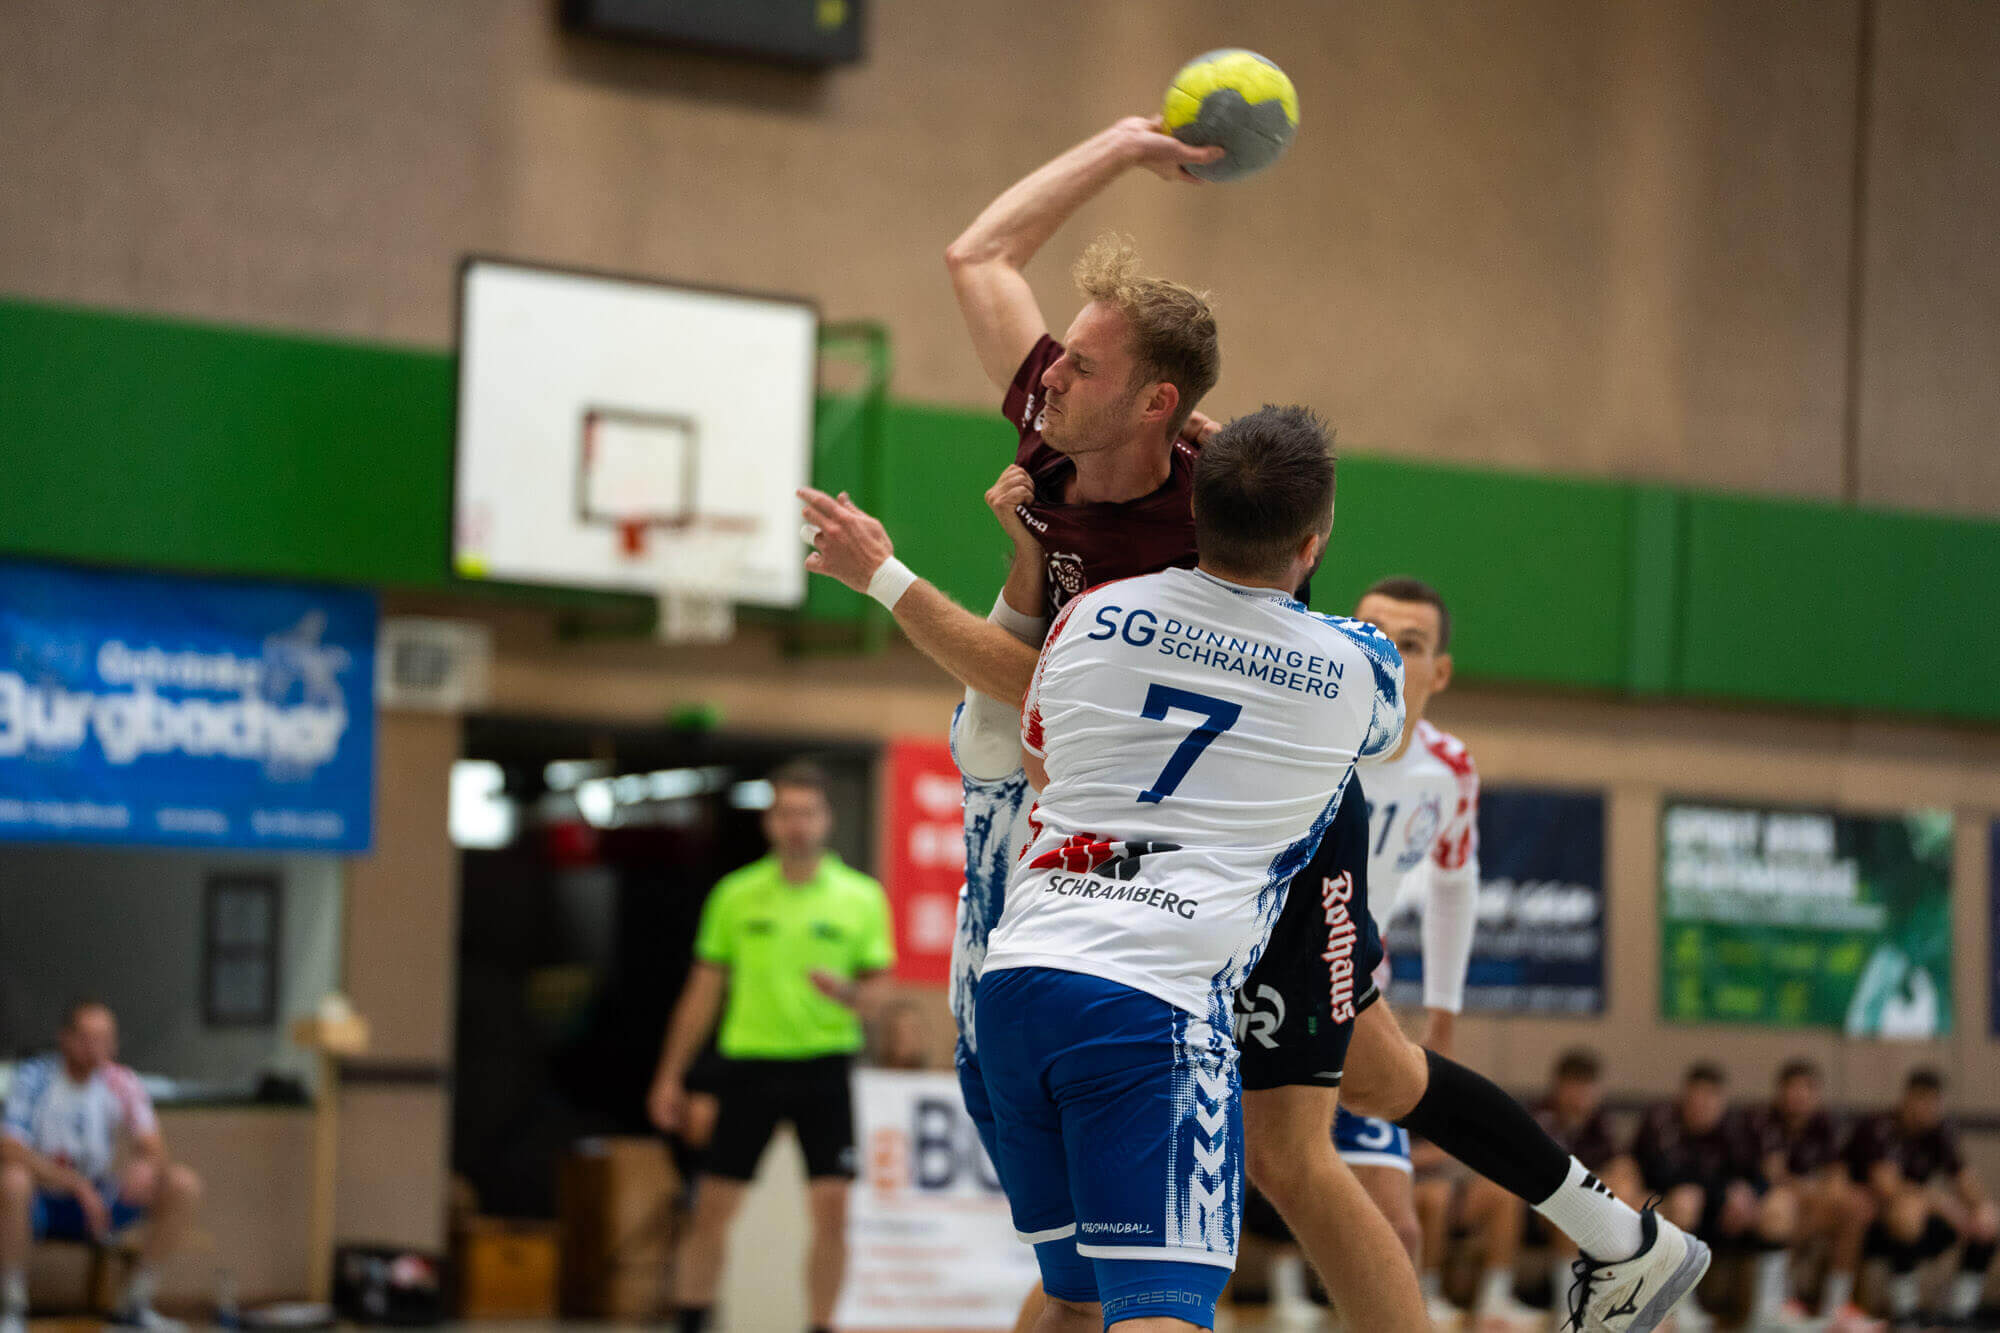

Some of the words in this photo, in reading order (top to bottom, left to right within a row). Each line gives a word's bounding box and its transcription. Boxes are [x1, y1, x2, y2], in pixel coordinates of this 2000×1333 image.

[1087, 605, 1158, 647] SG
[1164, 618, 1344, 680] DUNNINGEN
[1158, 637, 1341, 700] SCHRAMBERG
[1136, 682, 1243, 805] 7
[1045, 875, 1199, 920] SCHRAMBERG
[1321, 869, 1358, 1026] Rothaus
